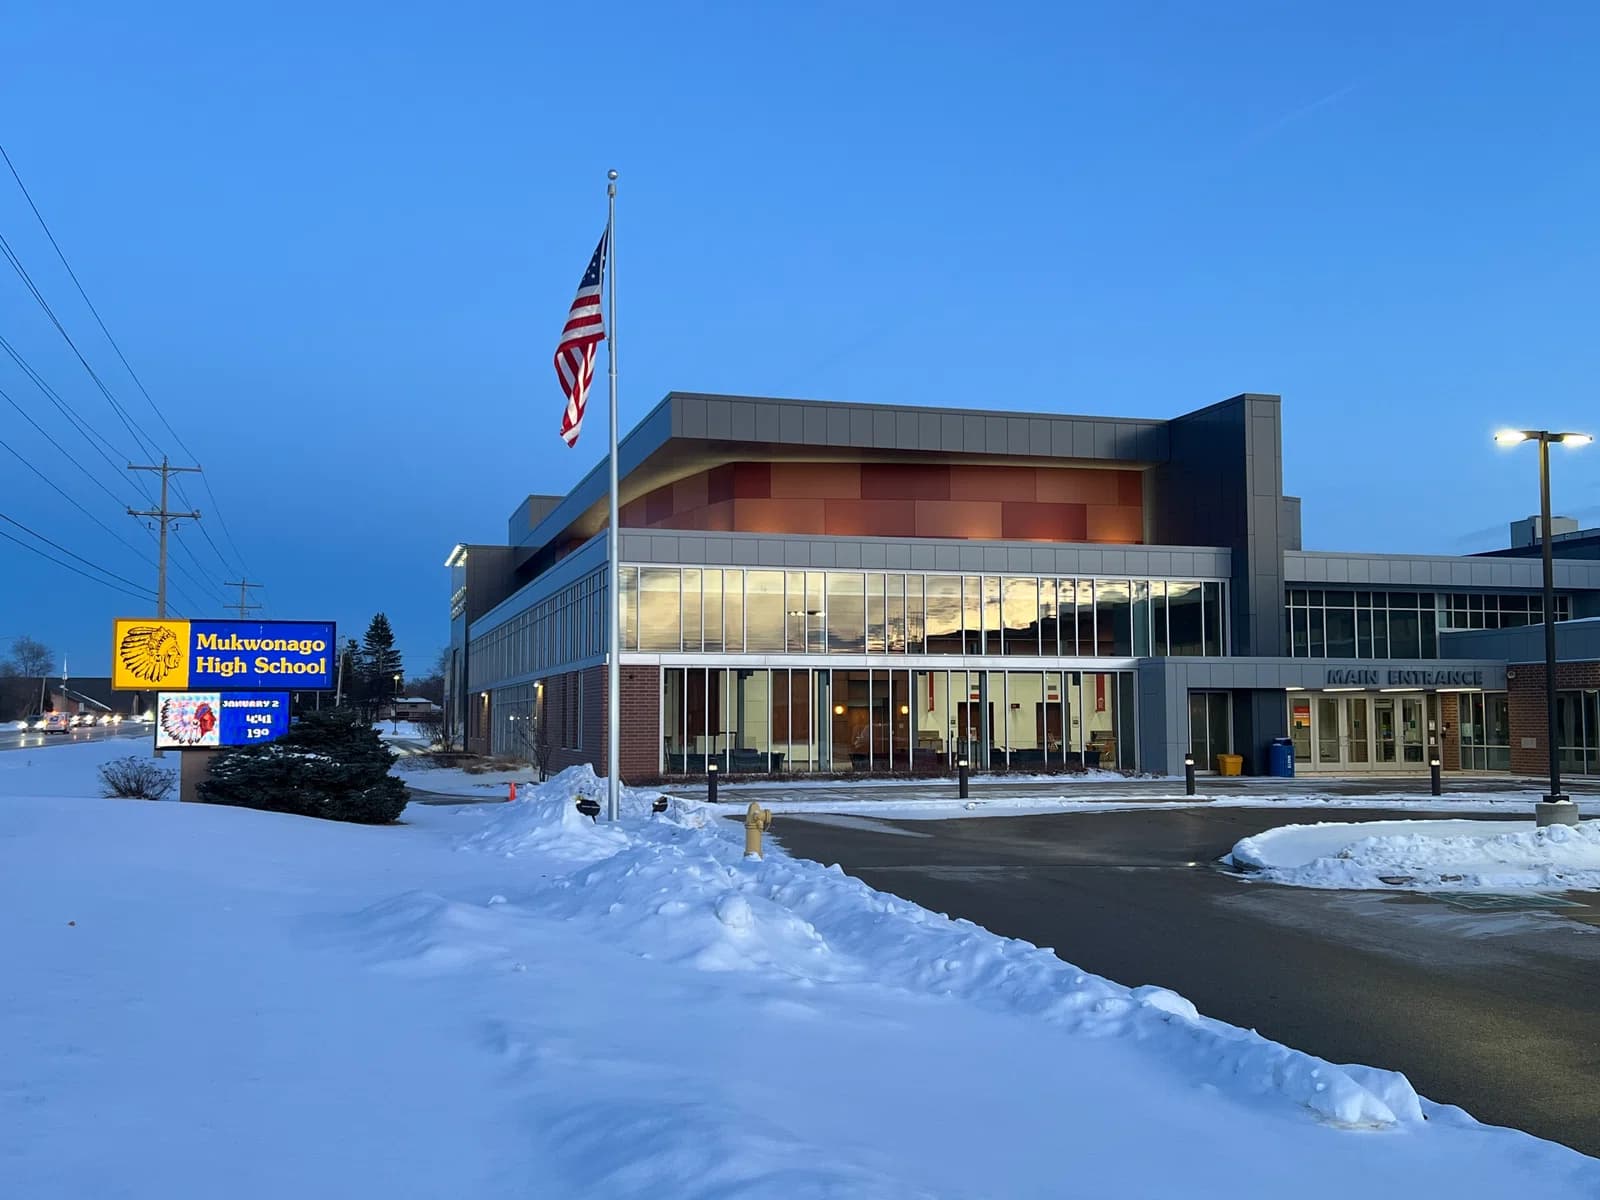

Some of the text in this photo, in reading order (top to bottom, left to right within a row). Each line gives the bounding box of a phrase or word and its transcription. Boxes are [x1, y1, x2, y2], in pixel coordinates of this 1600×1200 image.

[196, 633, 325, 655] Mukwonago
[196, 656, 327, 677] High School
[1327, 669, 1483, 686] MAIN ENTRANCE
[222, 700, 280, 708] JANUARY 2
